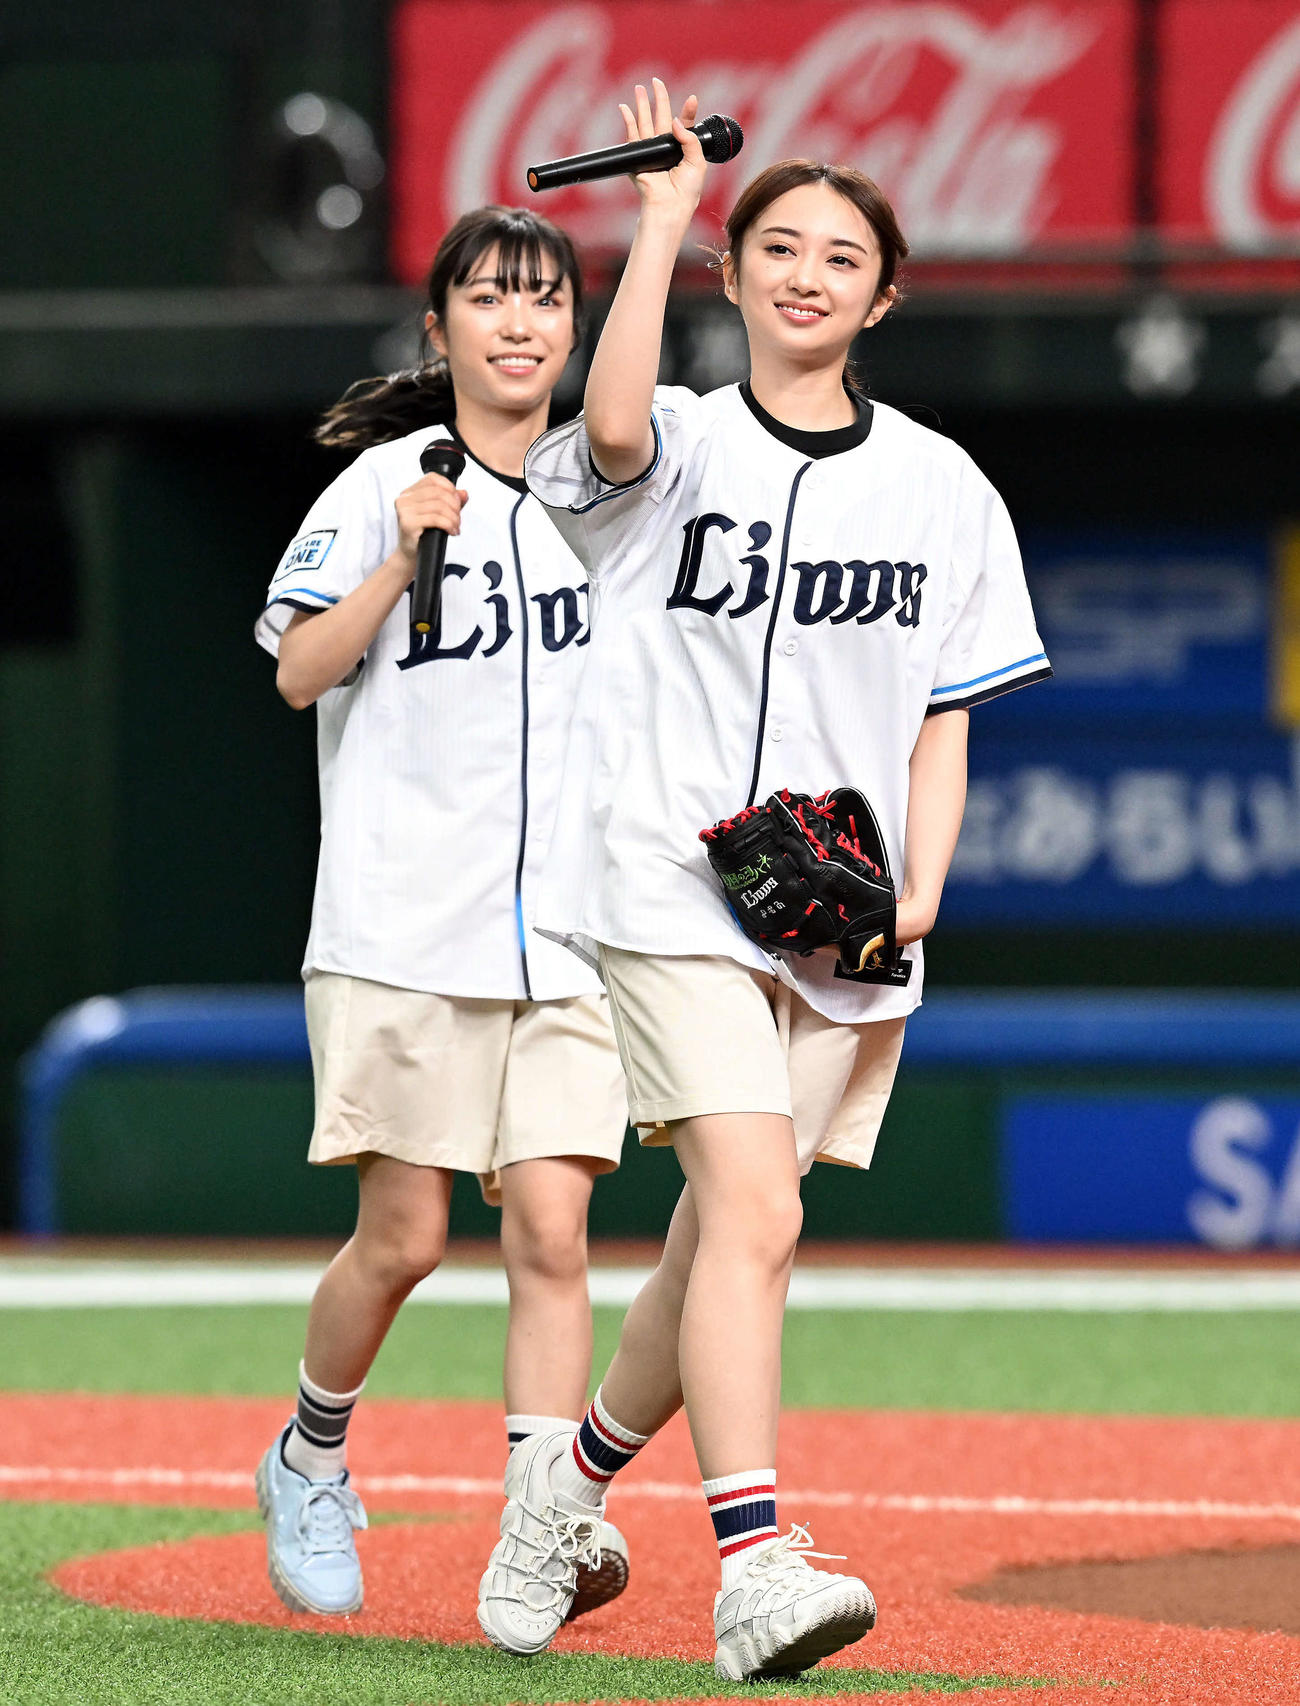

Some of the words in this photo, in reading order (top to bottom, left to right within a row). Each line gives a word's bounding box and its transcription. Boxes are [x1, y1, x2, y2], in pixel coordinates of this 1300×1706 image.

[443, 5, 1100, 260] CoCola
[395, 560, 592, 671] Lio
[666, 512, 928, 629] Lions
[740, 876, 779, 910] Lions
